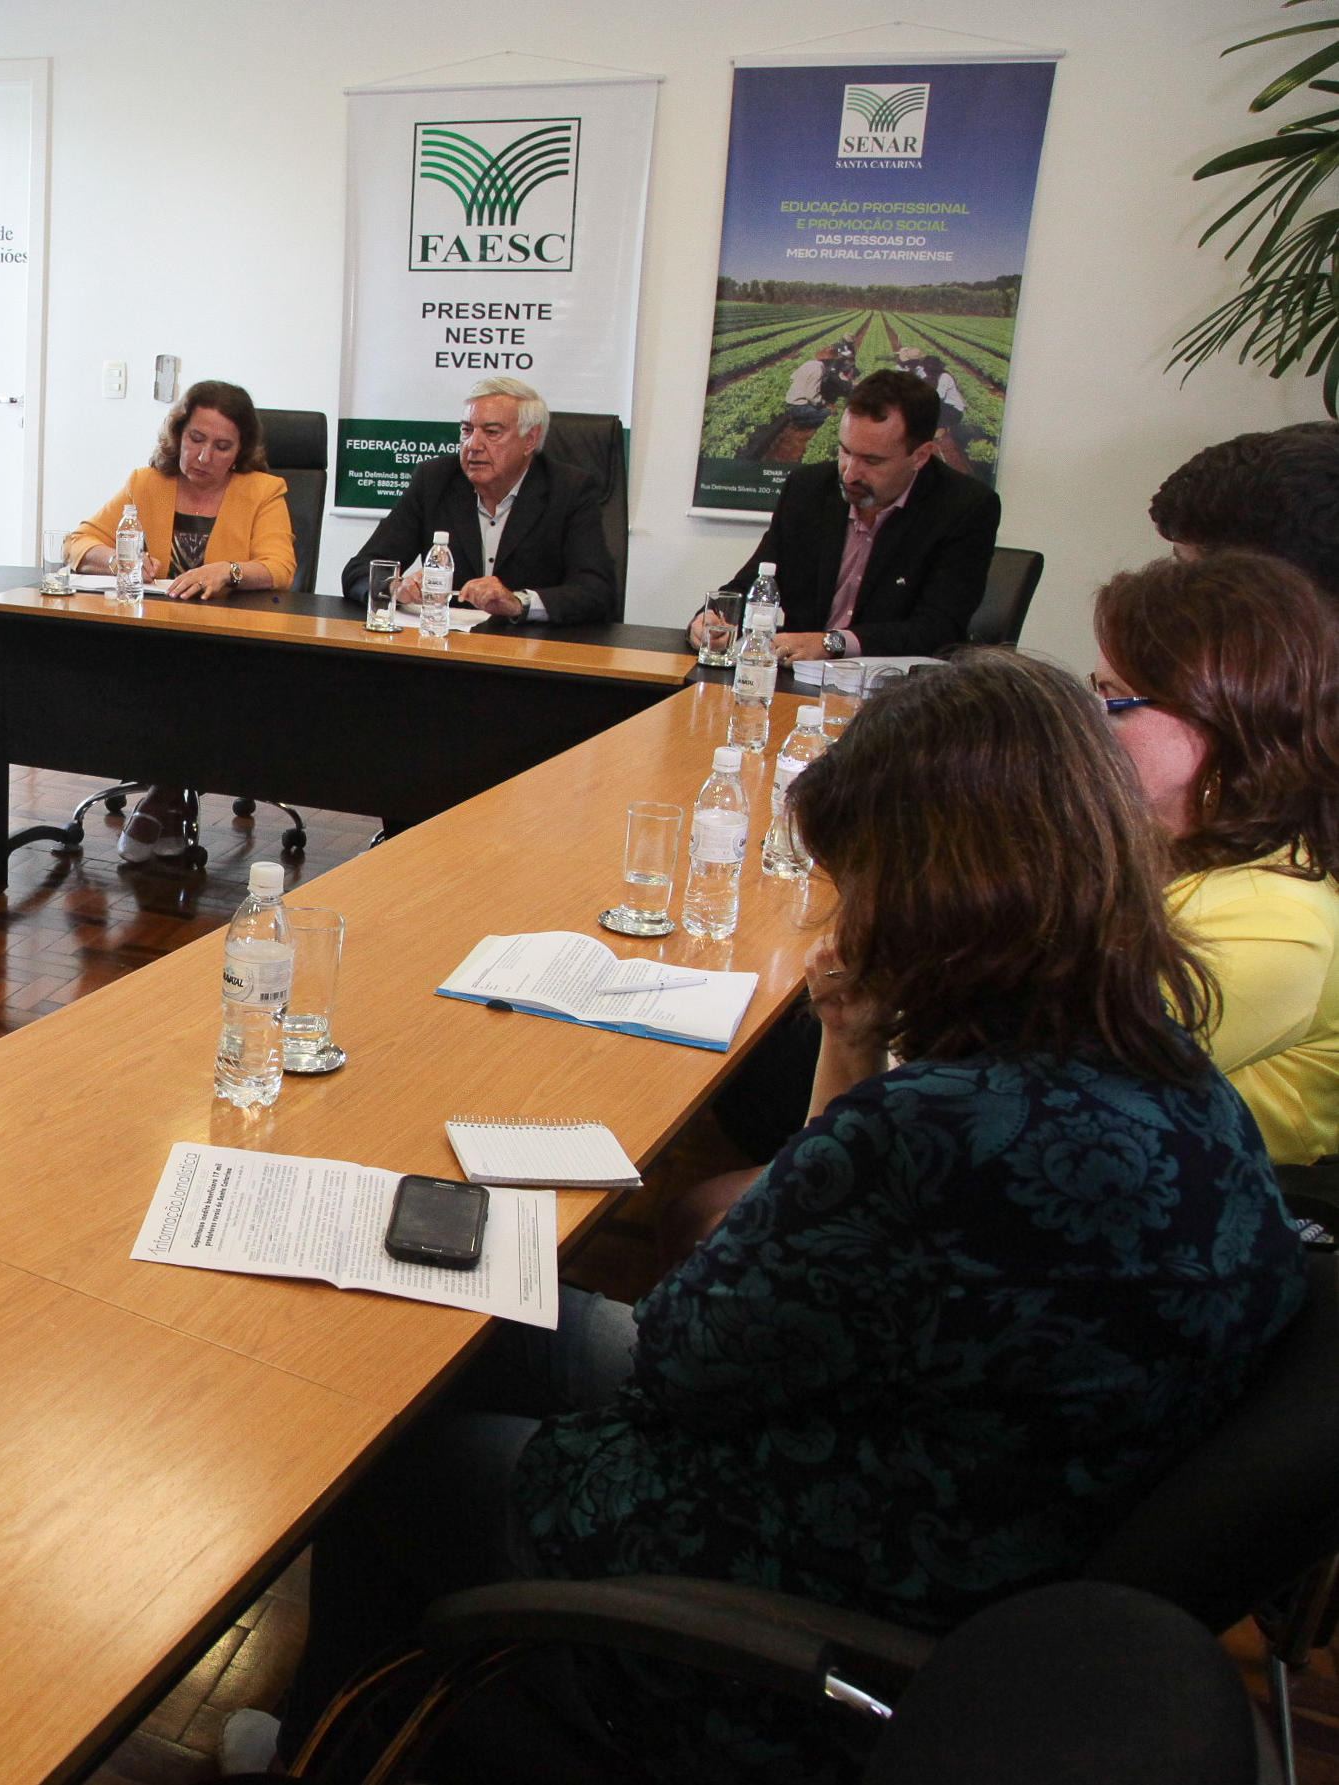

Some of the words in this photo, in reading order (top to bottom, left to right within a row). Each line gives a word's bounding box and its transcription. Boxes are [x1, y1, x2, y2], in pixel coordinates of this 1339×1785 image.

[843, 136, 918, 153] SENAR
[835, 160, 868, 169] SANTA
[870, 160, 923, 169] CATARINA
[780, 199, 860, 216] EDUCAÇÃO
[862, 202, 970, 215] PROFISSIONAL
[796, 218, 807, 229] E
[808, 217, 894, 233] PROMOÇÃO
[895, 219, 949, 232] SOCIAL
[815, 234, 842, 245] DAS
[844, 235, 904, 246] PESSOAS
[905, 236, 926, 246] DO
[417, 233, 566, 263] FAESC
[786, 248, 818, 259] MEIO
[819, 249, 862, 260] RURAL
[863, 250, 954, 262] CATARINENSE
[422, 302, 553, 320] PRESENTE
[445, 327, 526, 345] NESTE
[435, 351, 534, 370] EVENTO
[346, 439, 417, 454] FEDERAÇÃO
[419, 442, 436, 453] DA
[395, 453, 440, 464] ESTAD
[348, 470, 363, 478] Rua
[364, 470, 399, 479] Delminda
[357, 479, 376, 487] CEP:
